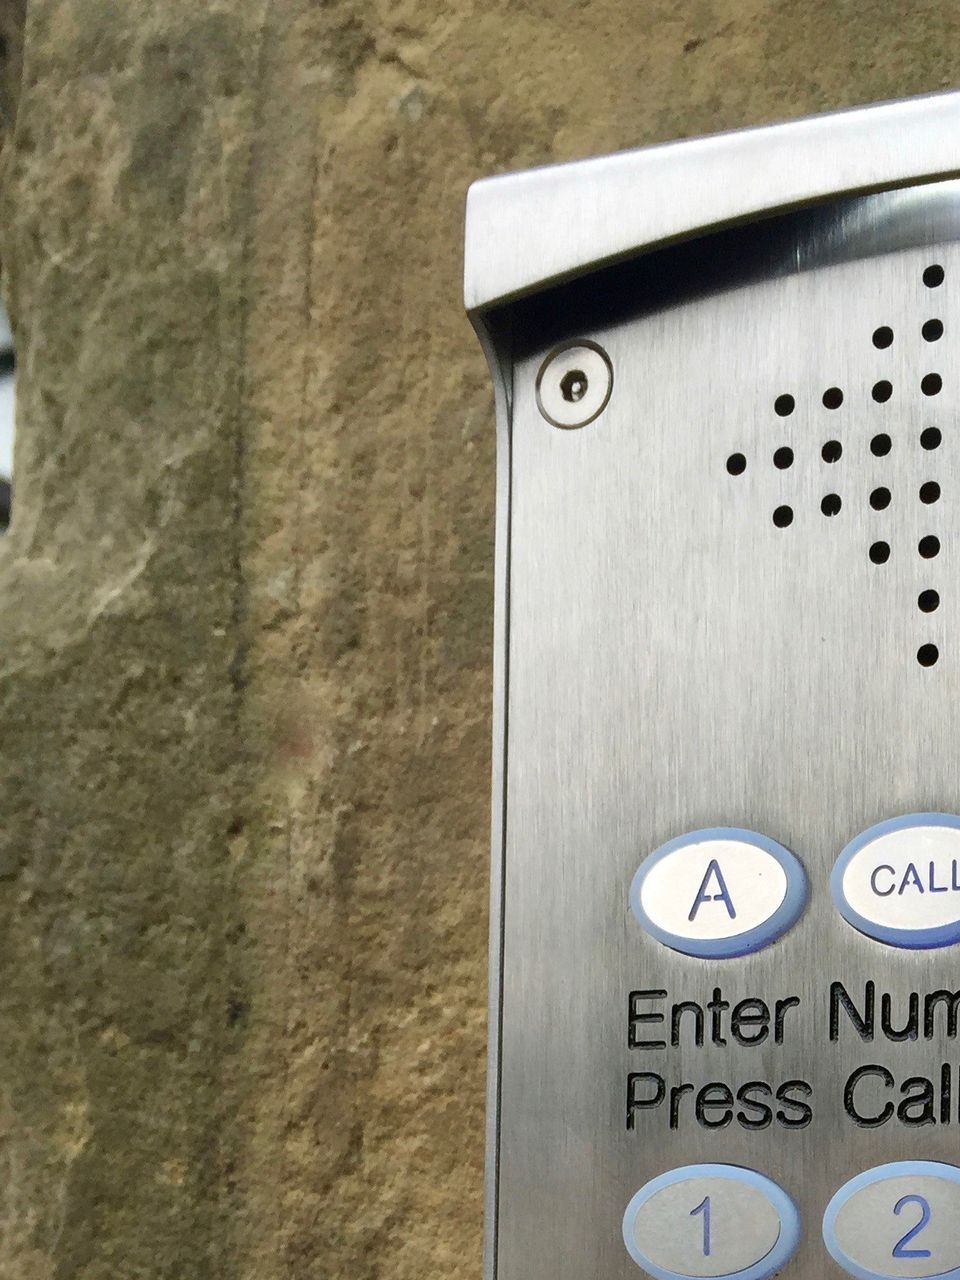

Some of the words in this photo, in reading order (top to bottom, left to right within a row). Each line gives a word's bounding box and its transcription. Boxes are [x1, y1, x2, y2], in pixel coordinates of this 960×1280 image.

[688, 859, 737, 921] A
[628, 987, 800, 1051] Enter
[626, 1070, 813, 1131] Press
[689, 1196, 711, 1256] 1
[892, 1194, 931, 1258] 2
